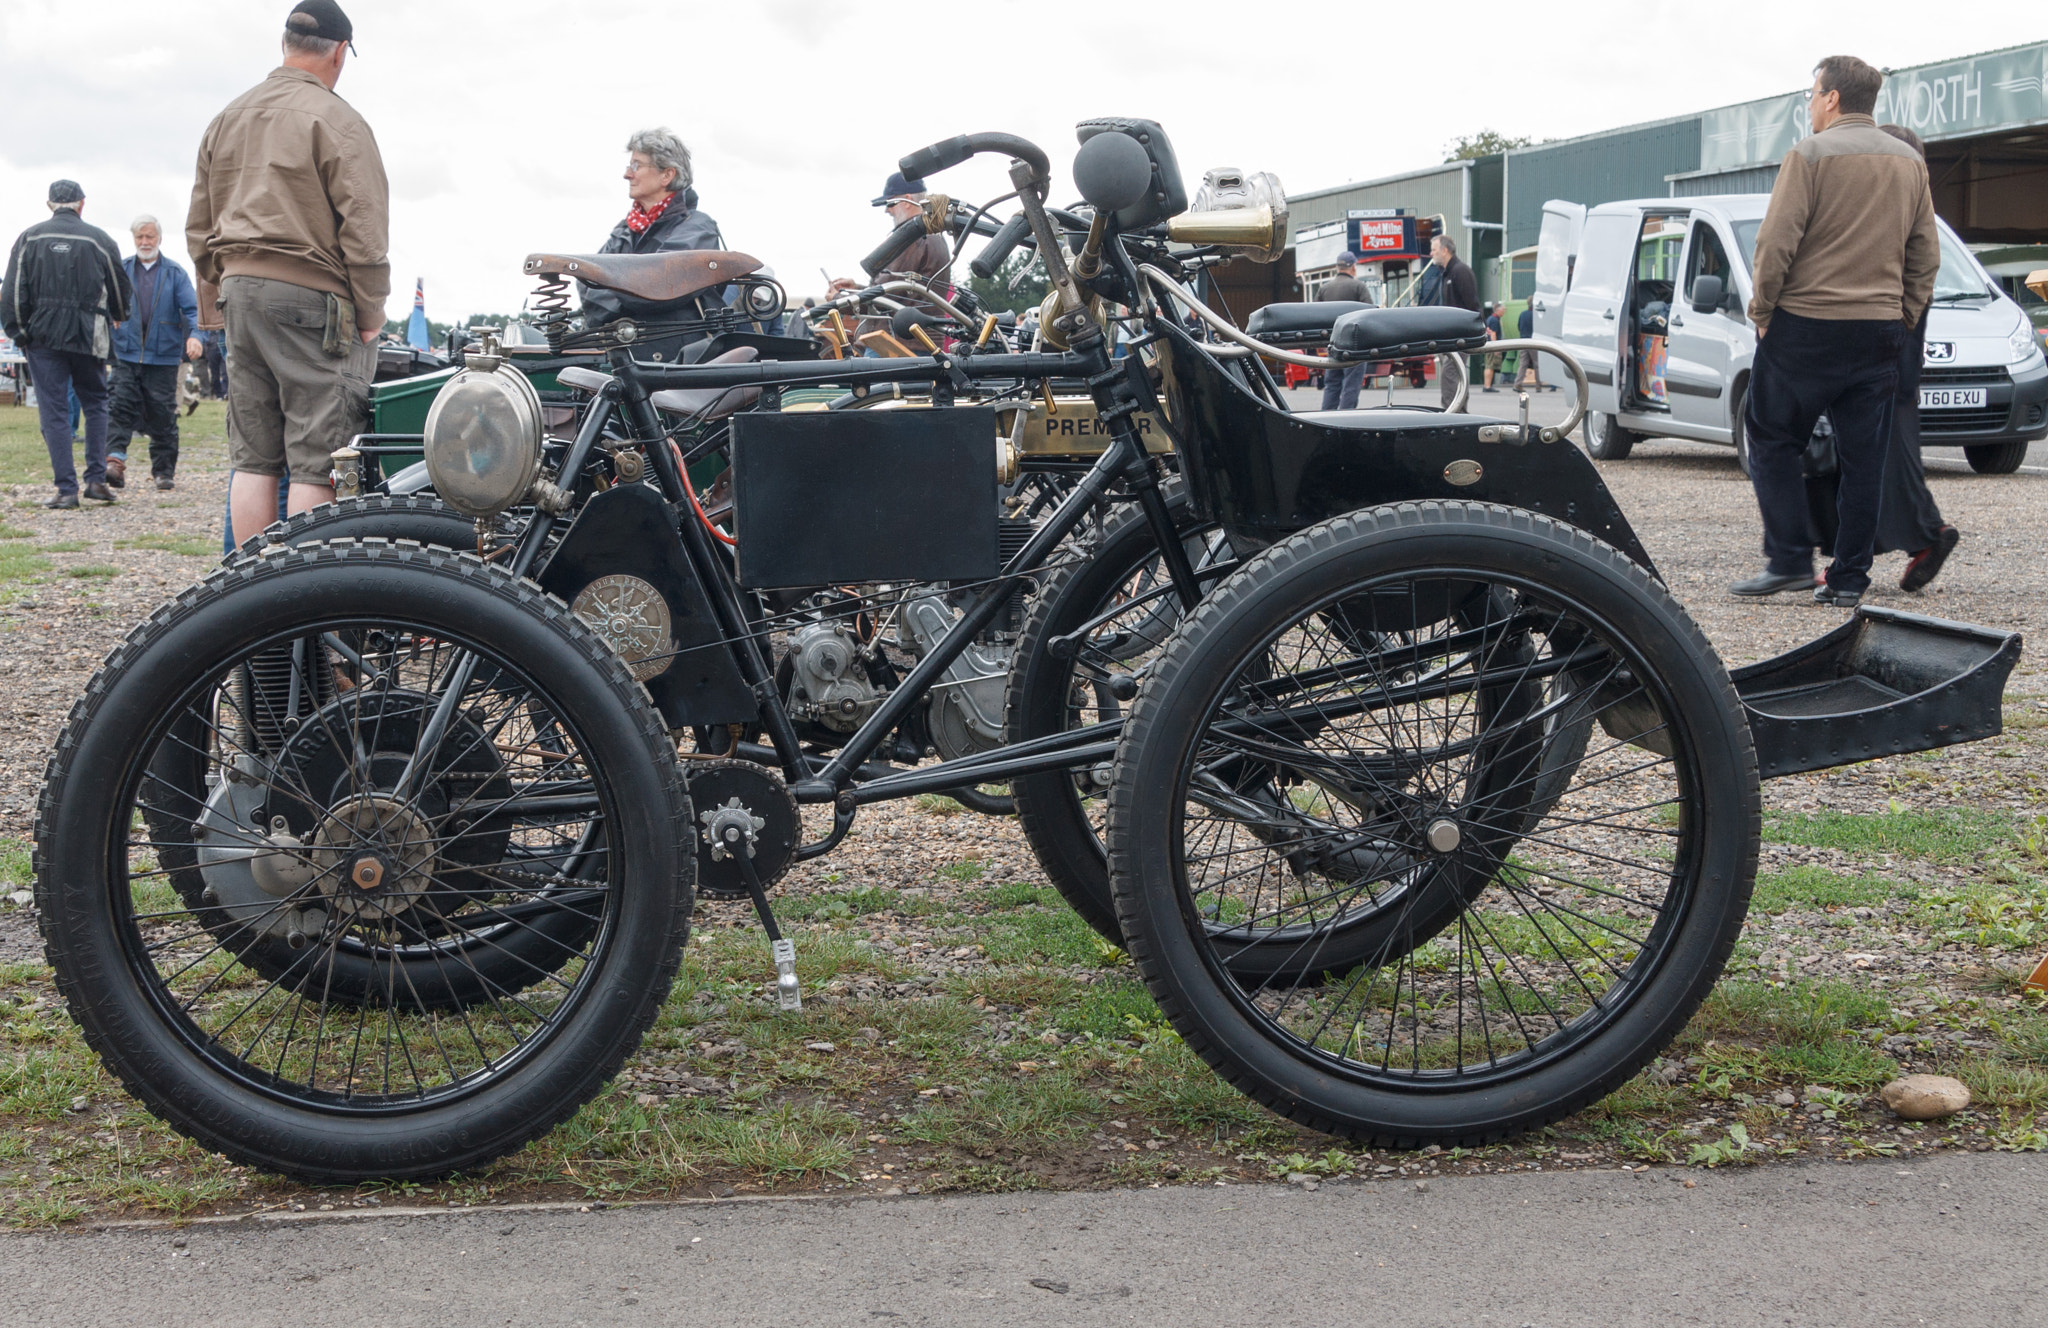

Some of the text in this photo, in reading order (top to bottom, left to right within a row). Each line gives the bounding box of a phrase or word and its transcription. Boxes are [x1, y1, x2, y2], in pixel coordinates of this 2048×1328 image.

[1792, 70, 1982, 146] SEWORTH
[1366, 236, 1395, 249] Tyres
[1918, 390, 1980, 406] T60 EXU
[1046, 418, 1151, 436] PREMR
